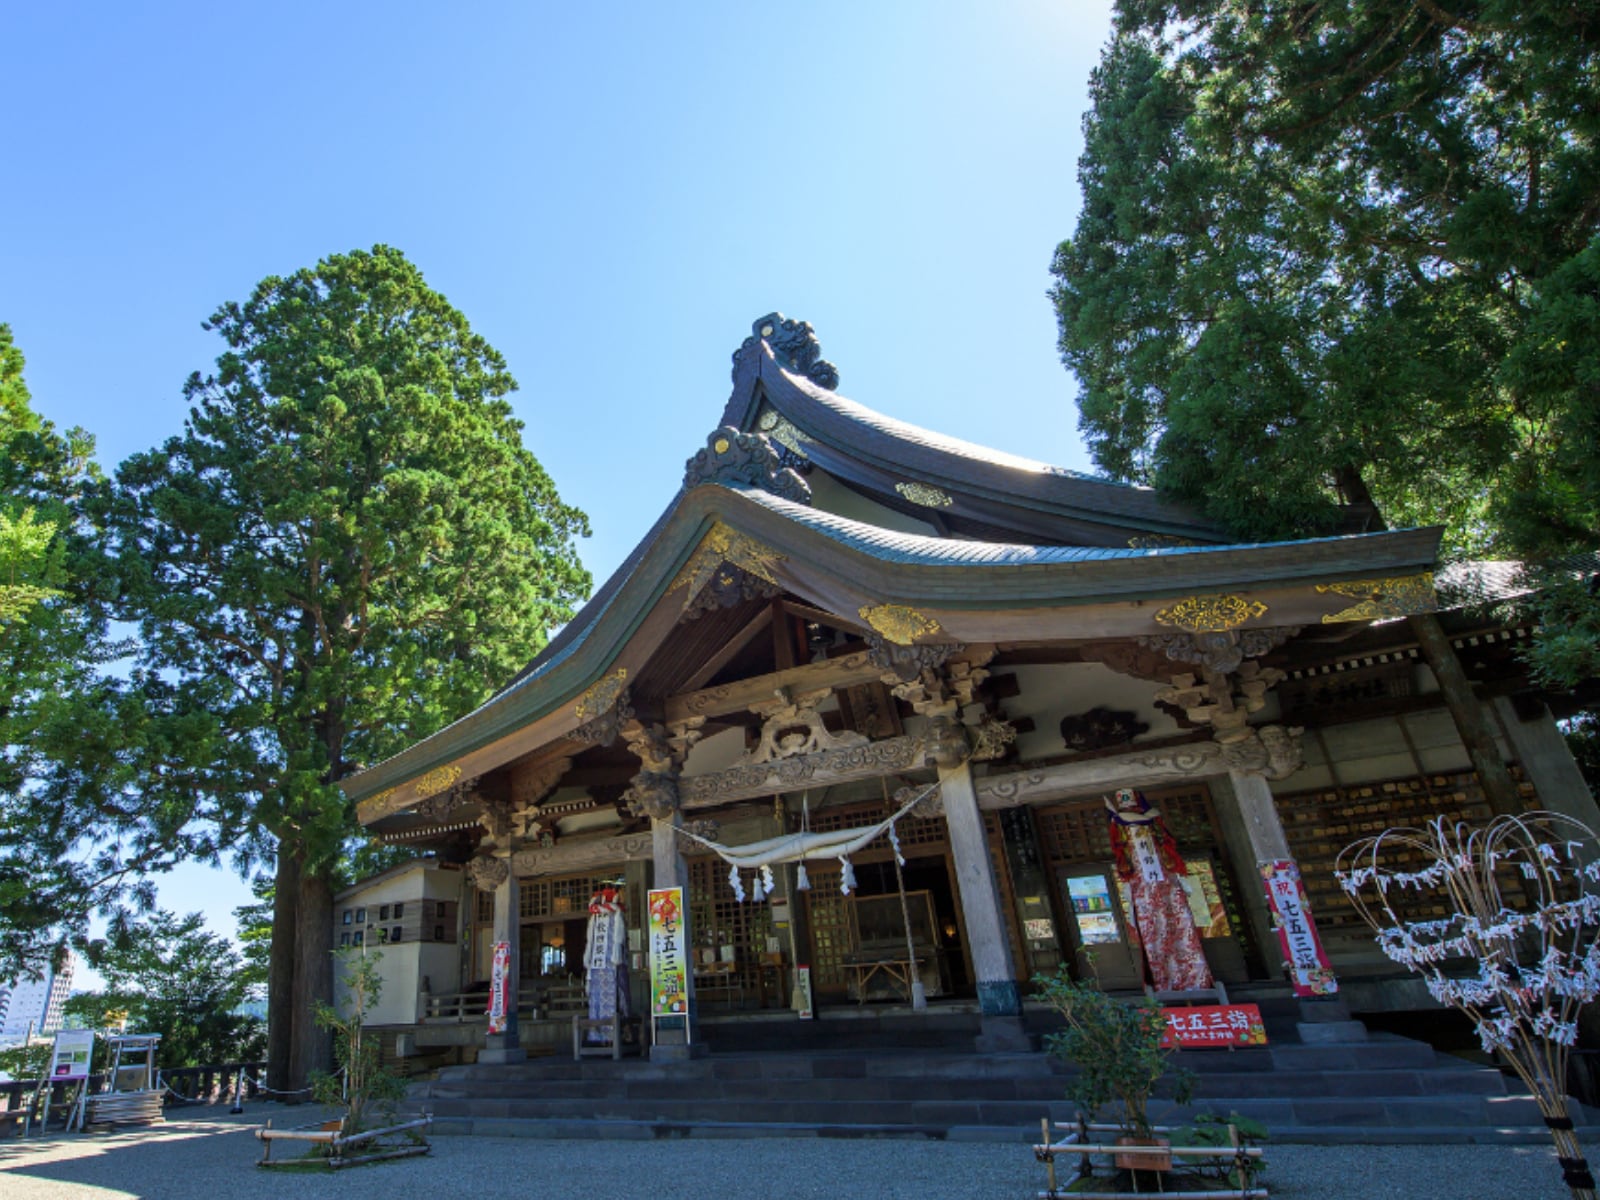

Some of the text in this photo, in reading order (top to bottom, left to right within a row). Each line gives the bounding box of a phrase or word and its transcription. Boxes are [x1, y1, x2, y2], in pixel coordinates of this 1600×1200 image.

[662, 916, 678, 995] 七五三詣
[1166, 1009, 1249, 1030] 七五三詣
